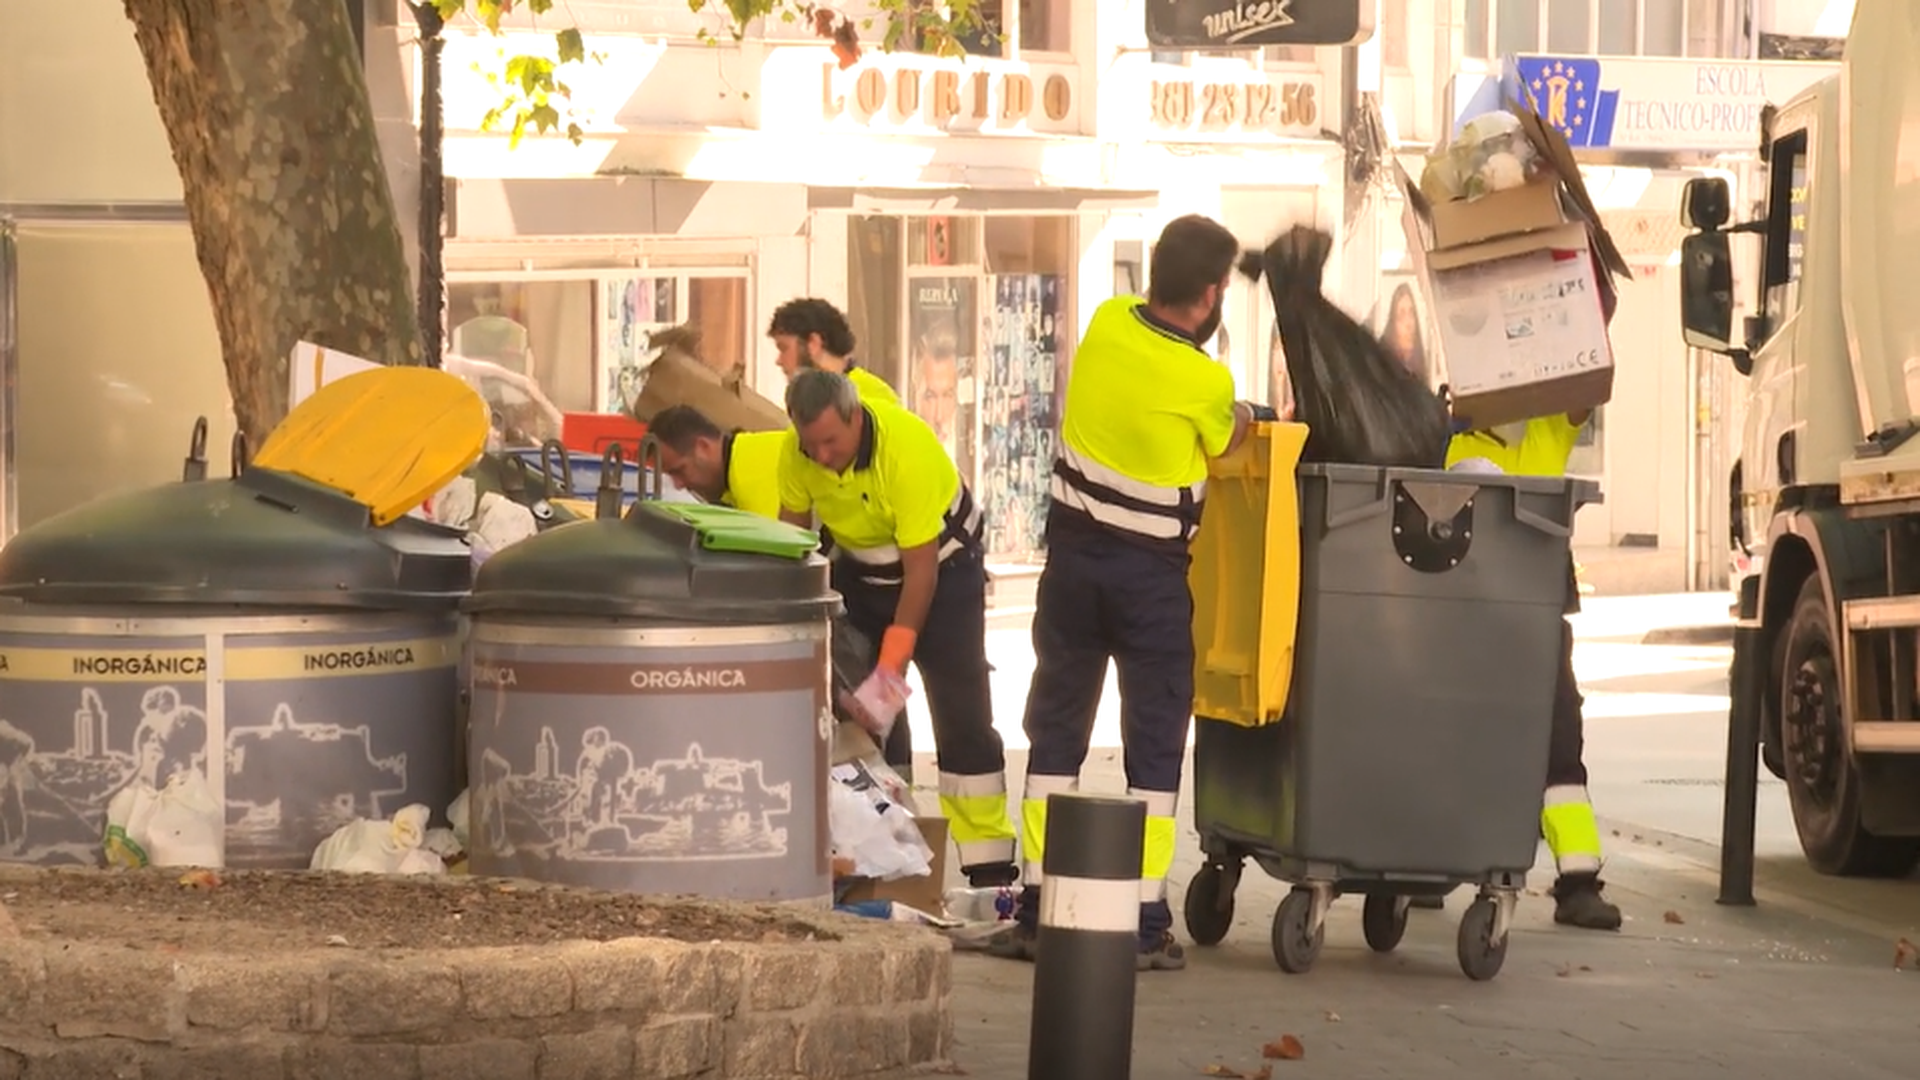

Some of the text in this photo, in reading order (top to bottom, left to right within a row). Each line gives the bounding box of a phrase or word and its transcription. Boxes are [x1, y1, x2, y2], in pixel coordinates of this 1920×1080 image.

[822, 62, 1071, 121] LOURIDO
[1696, 66, 1766, 97] ESCOLA
[1625, 101, 1761, 132] TECNICO-PROF
[305, 646, 415, 670] INORGÁNICA
[630, 666, 746, 689] ORGÁNICA
